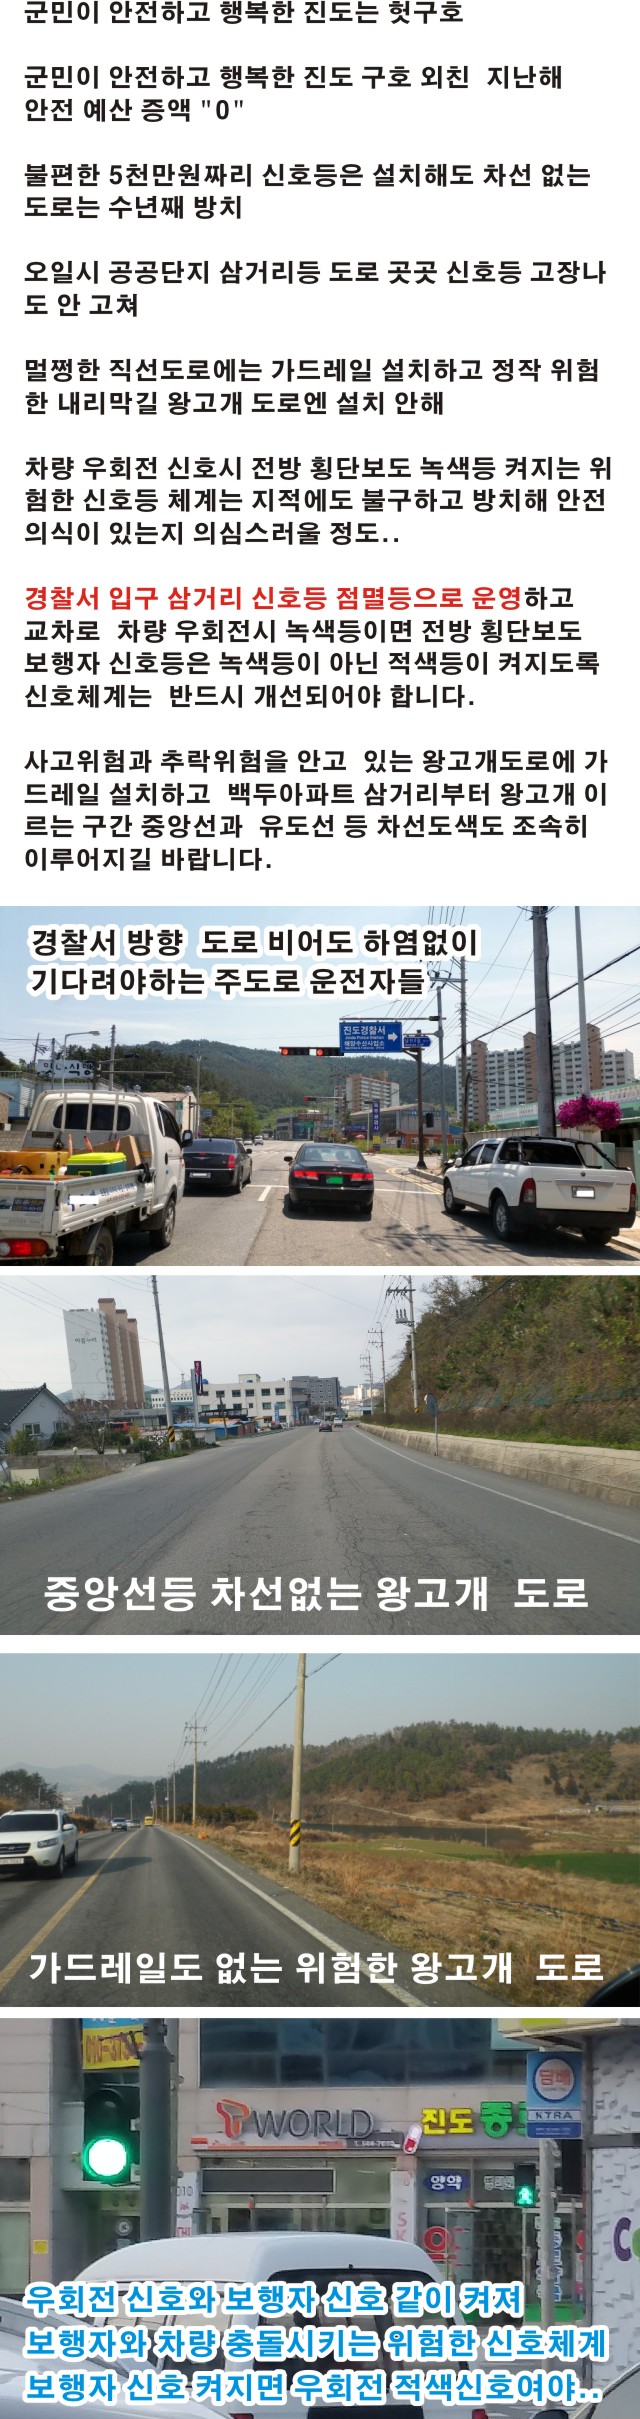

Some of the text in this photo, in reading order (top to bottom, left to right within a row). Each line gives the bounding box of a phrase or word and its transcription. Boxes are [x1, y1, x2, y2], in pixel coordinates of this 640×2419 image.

[343, 1026, 386, 1035] 진도경찰서
[539, 2069, 571, 2086] 담배
[252, 2109, 374, 2139] WORLD
[421, 2107, 475, 2136] 진도
